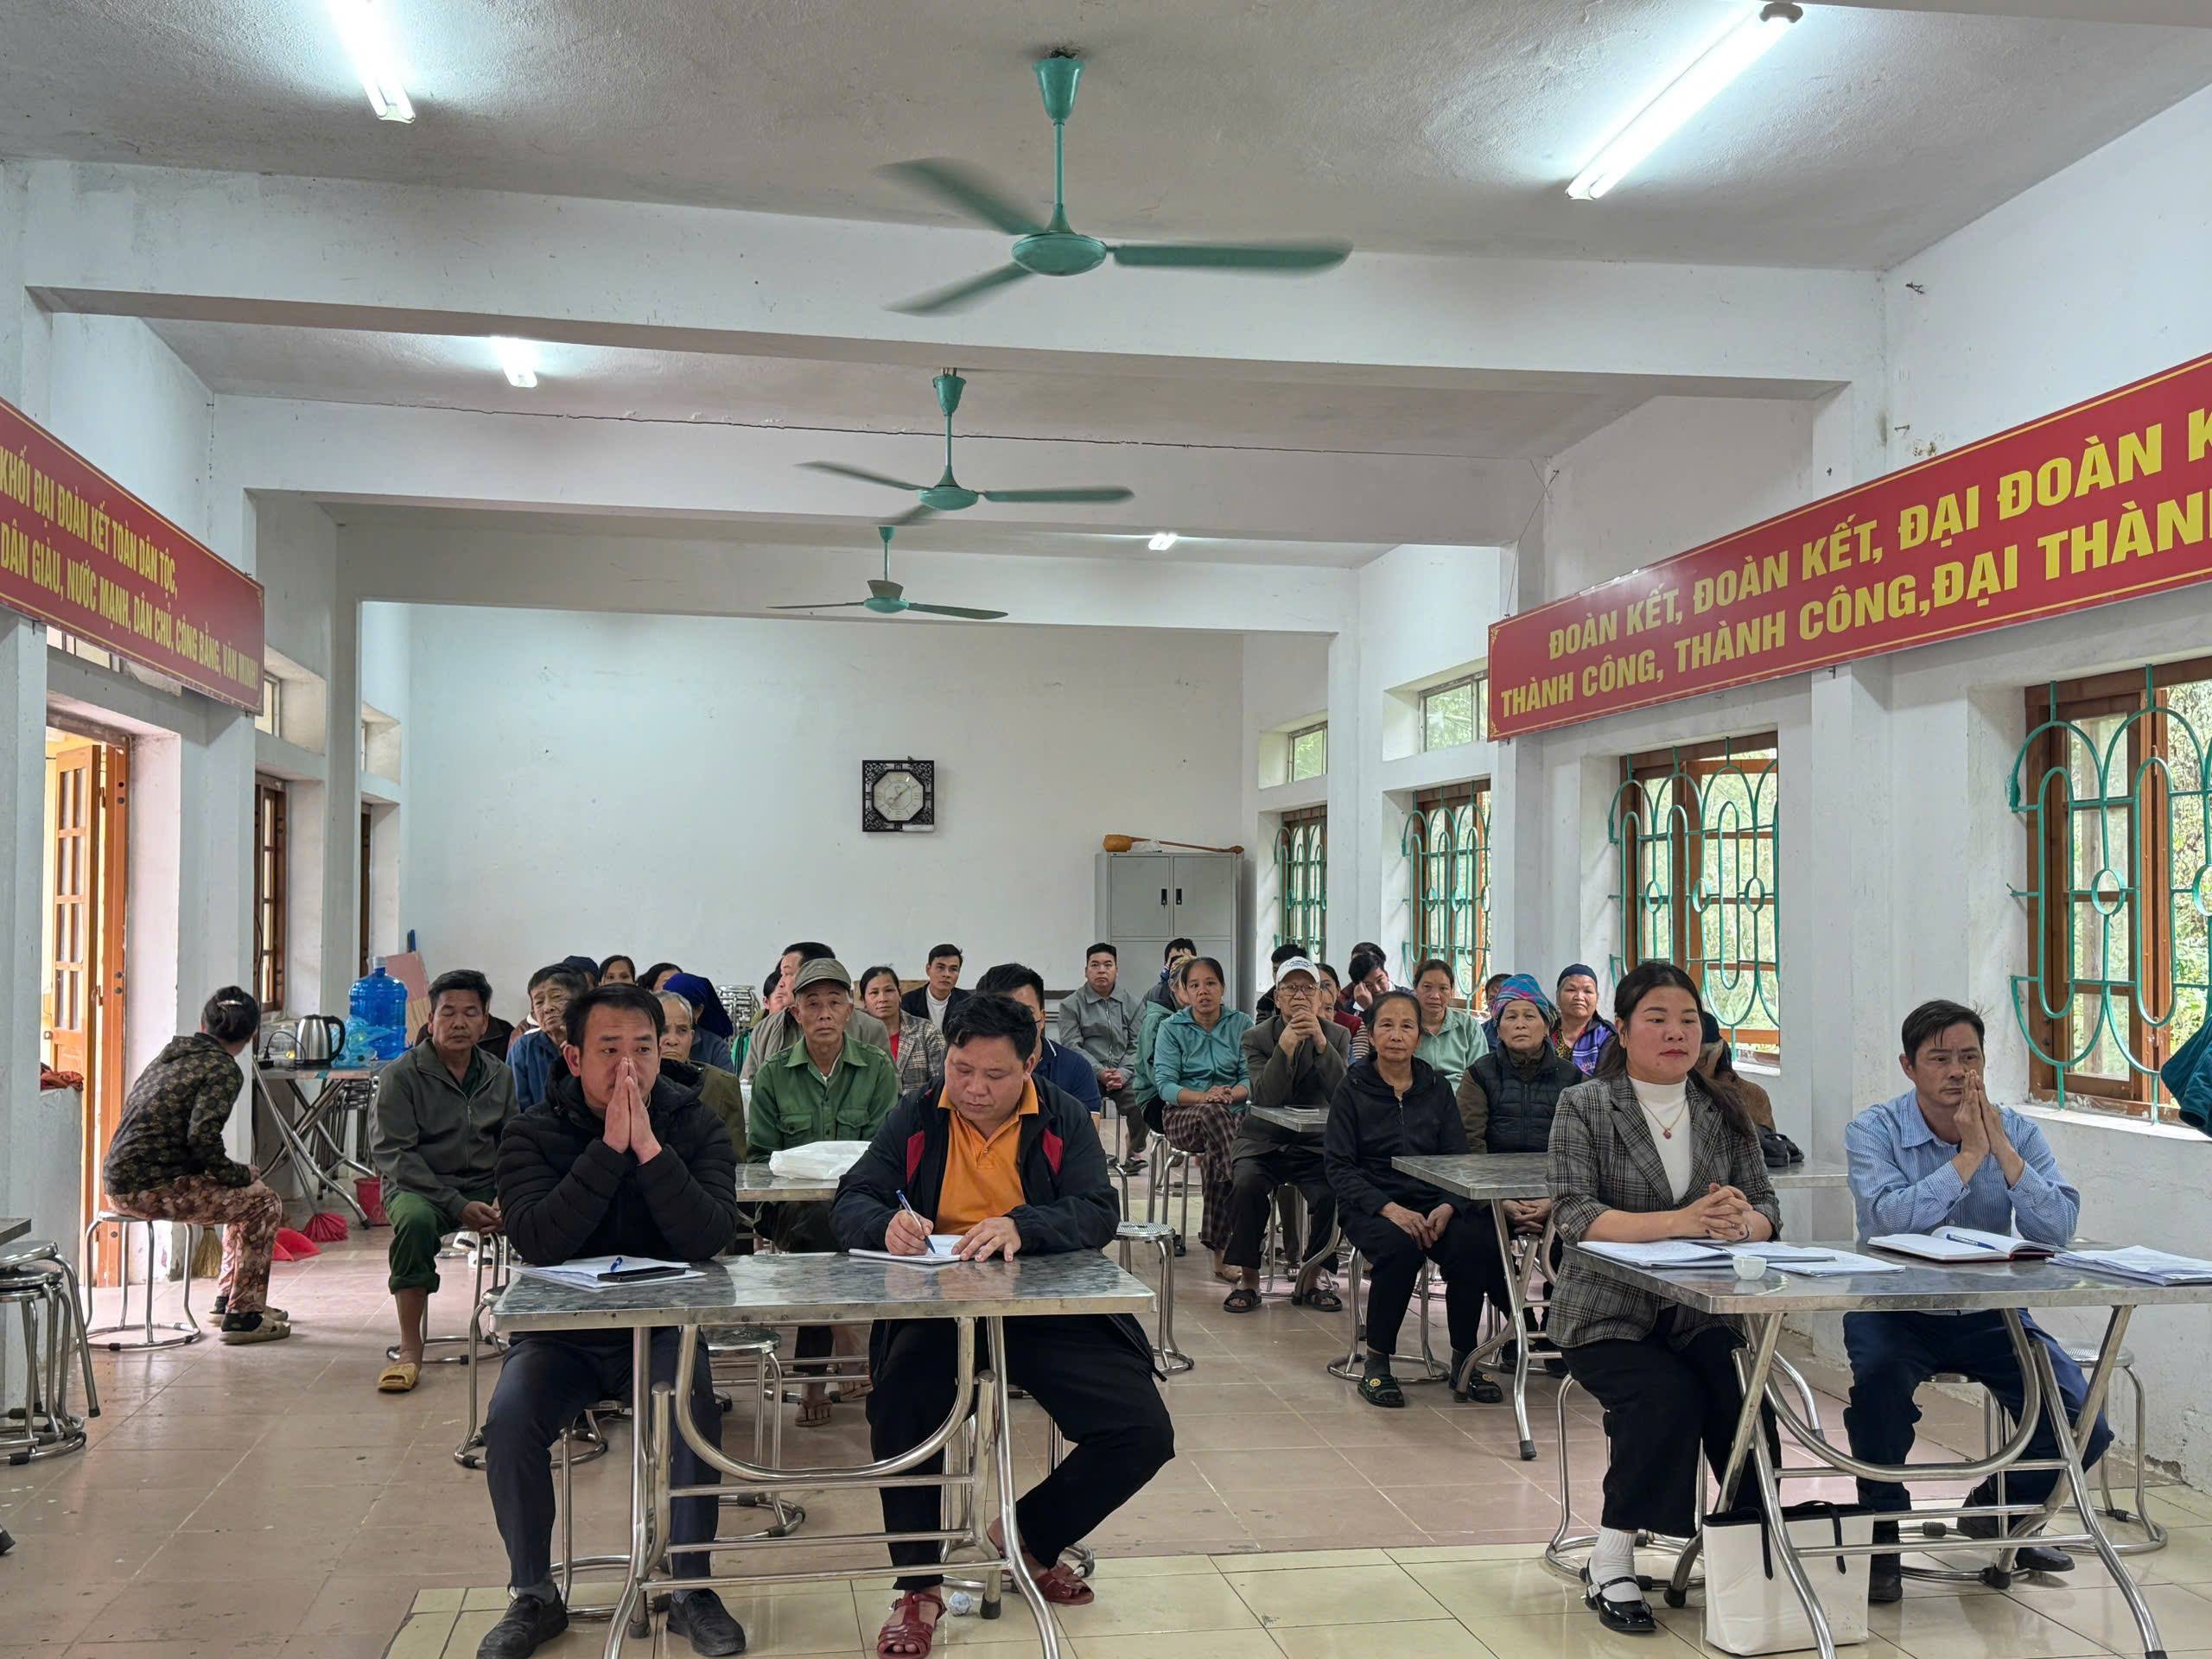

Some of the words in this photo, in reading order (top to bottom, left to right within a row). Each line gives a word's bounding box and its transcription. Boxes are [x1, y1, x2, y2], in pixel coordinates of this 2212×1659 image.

[0, 445, 30, 507] KHỐI
[34, 468, 54, 528] ĐẠI
[57, 485, 88, 543] ĐOÀN
[91, 500, 110, 555] KẾT
[112, 519, 137, 572] TOÀN
[139, 534, 157, 583] DÂN
[159, 547, 178, 600] TỘC,
[1, 518, 29, 579] DÂN
[32, 537, 64, 601] GIÀU,
[67, 559, 97, 612] NƯỚC
[99, 576, 131, 634] MẠNH,
[134, 592, 153, 640] DÂN
[176, 614, 198, 663] CÔNG
[1501, 671, 1573, 717] THÀNH
[1582, 649, 1663, 697] CÔNG,
[1675, 610, 1785, 673] THÀNH
[2037, 488, 2212, 580] THÀN
[1548, 612, 1618, 660] ĐOÀN
[1626, 582, 1682, 636] KẾT,
[1693, 550, 1789, 615] ĐOÀN
[1802, 513, 1883, 581] KẾT,
[1898, 485, 1980, 550] ĐẠI
[1997, 423, 2162, 520] ĐOÀN
